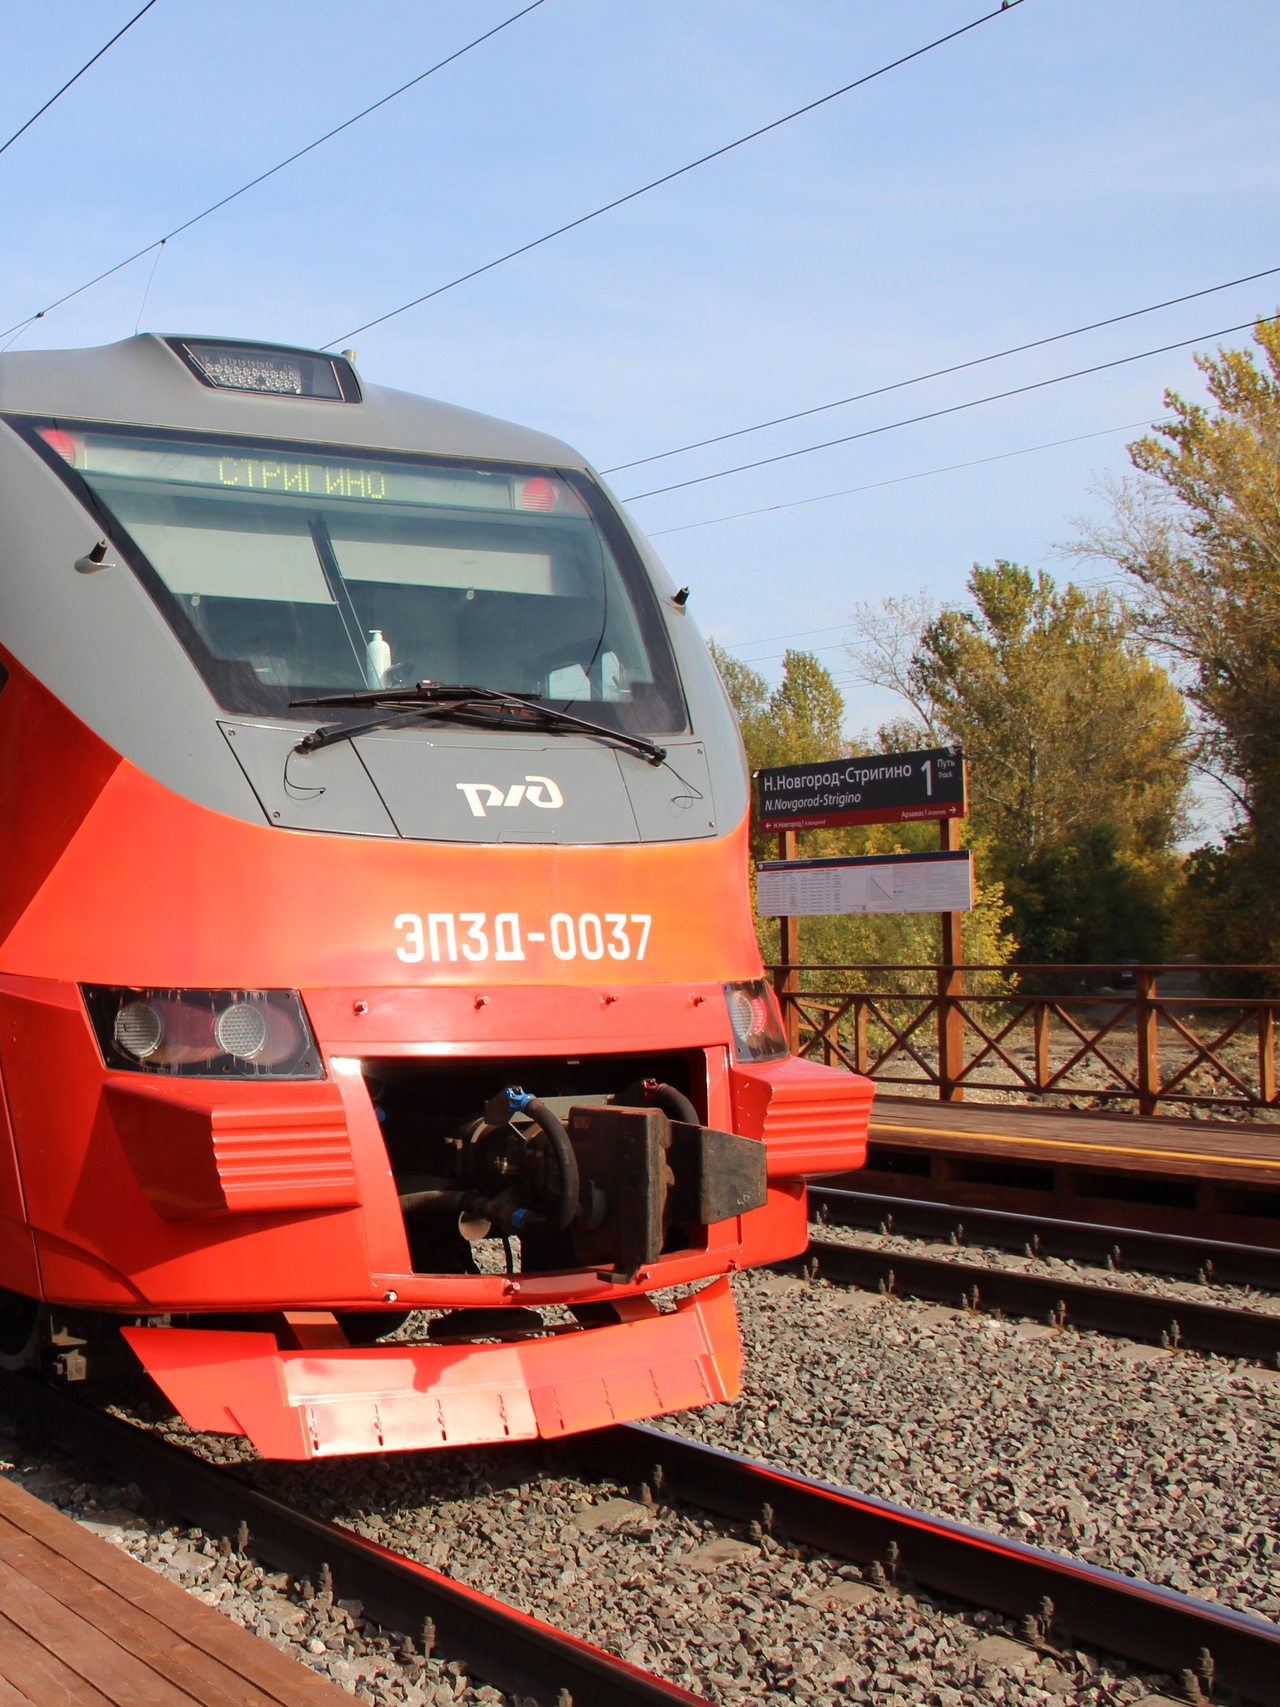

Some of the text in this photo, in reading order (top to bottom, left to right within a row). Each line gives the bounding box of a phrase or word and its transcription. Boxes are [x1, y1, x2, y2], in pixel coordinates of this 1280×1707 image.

[219, 456, 386, 500] СТРИГИНО
[937, 759, 956, 769] Путь
[938, 771, 953, 779] Track
[764, 764, 912, 792] Н.Новгород-Стригино
[921, 760, 933, 796] 1
[765, 791, 862, 812] N.Novgorod-Strigino
